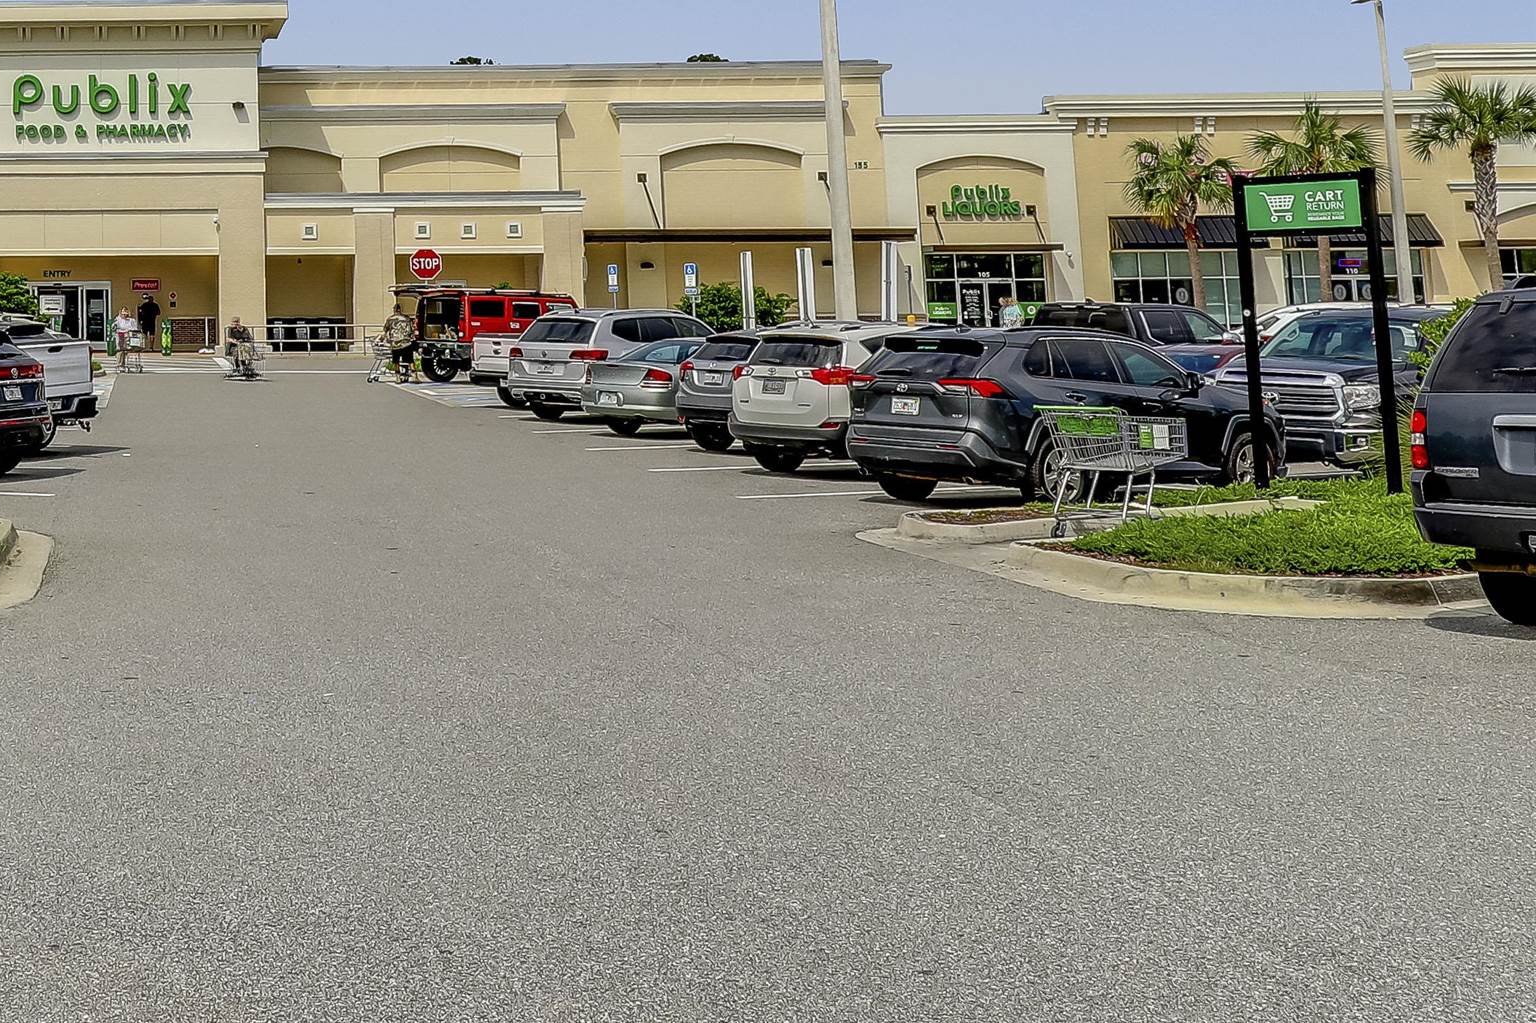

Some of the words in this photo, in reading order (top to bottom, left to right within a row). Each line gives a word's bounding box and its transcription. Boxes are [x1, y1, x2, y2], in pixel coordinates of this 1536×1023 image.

[13, 72, 191, 114] Publix
[16, 124, 65, 138] FOOD
[75, 124, 87, 138] &
[96, 124, 189, 138] PHARMACY
[950, 184, 1011, 200] Publix
[1304, 190, 1344, 202] CART
[942, 200, 1022, 217] LIQUORS
[1306, 201, 1344, 211] RETURN
[412, 258, 440, 270] STOP
[43, 270, 72, 278] ENTRY
